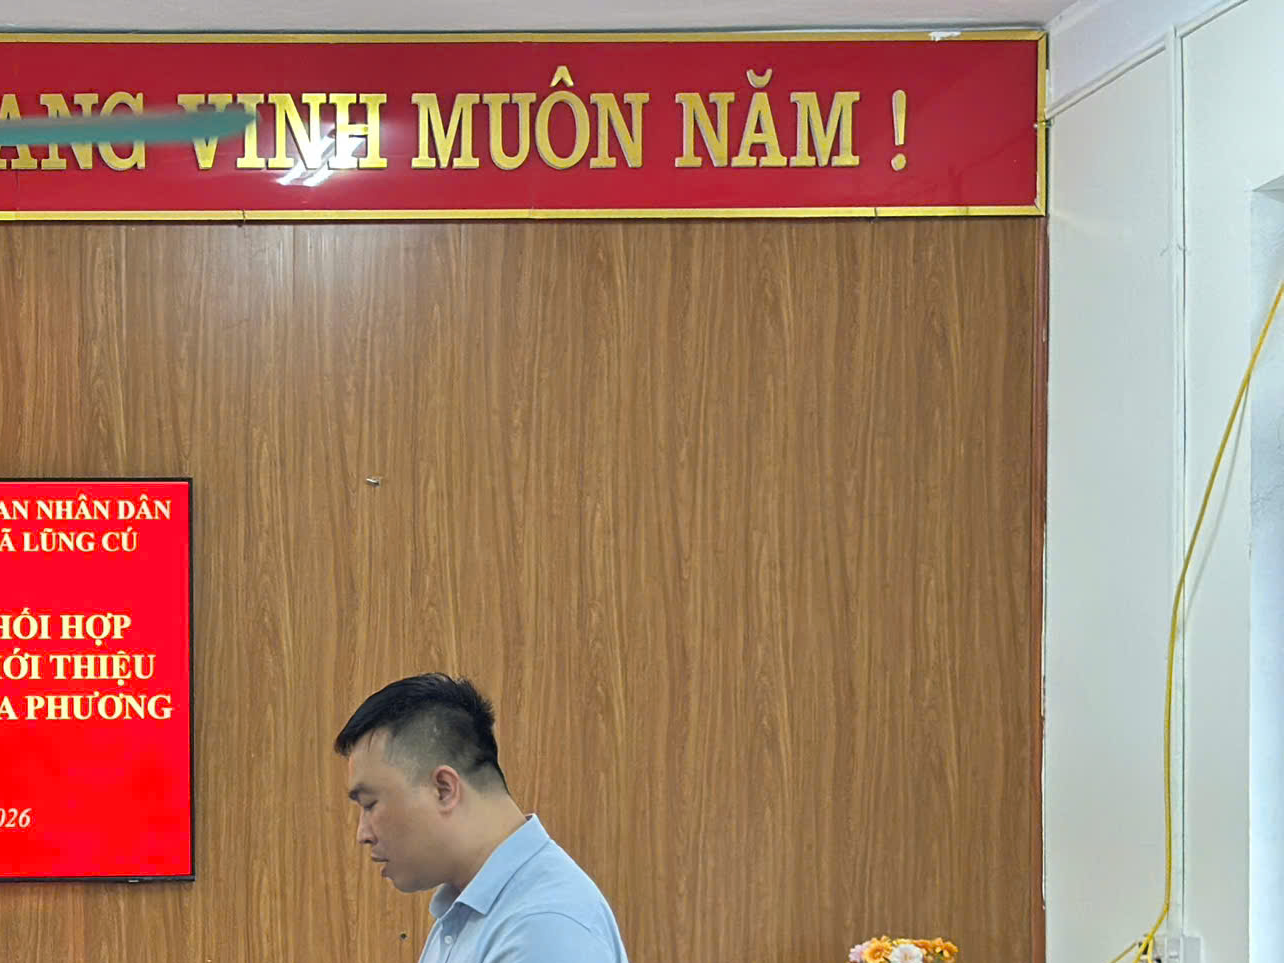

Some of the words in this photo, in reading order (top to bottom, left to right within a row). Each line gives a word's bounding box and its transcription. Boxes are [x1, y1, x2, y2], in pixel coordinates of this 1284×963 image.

[177, 92, 388, 169] VINH
[411, 66, 650, 170] MUÔN
[675, 69, 861, 168] NĂM
[890, 90, 908, 171] !
[36, 493, 111, 521] NHÂN
[117, 493, 171, 520] DÂN
[22, 527, 95, 553] LŨNG
[101, 526, 138, 553] CÚ
[59, 612, 132, 647] HỢP
[49, 650, 157, 687] THIỆU
[24, 690, 173, 721] PHƯƠNG
